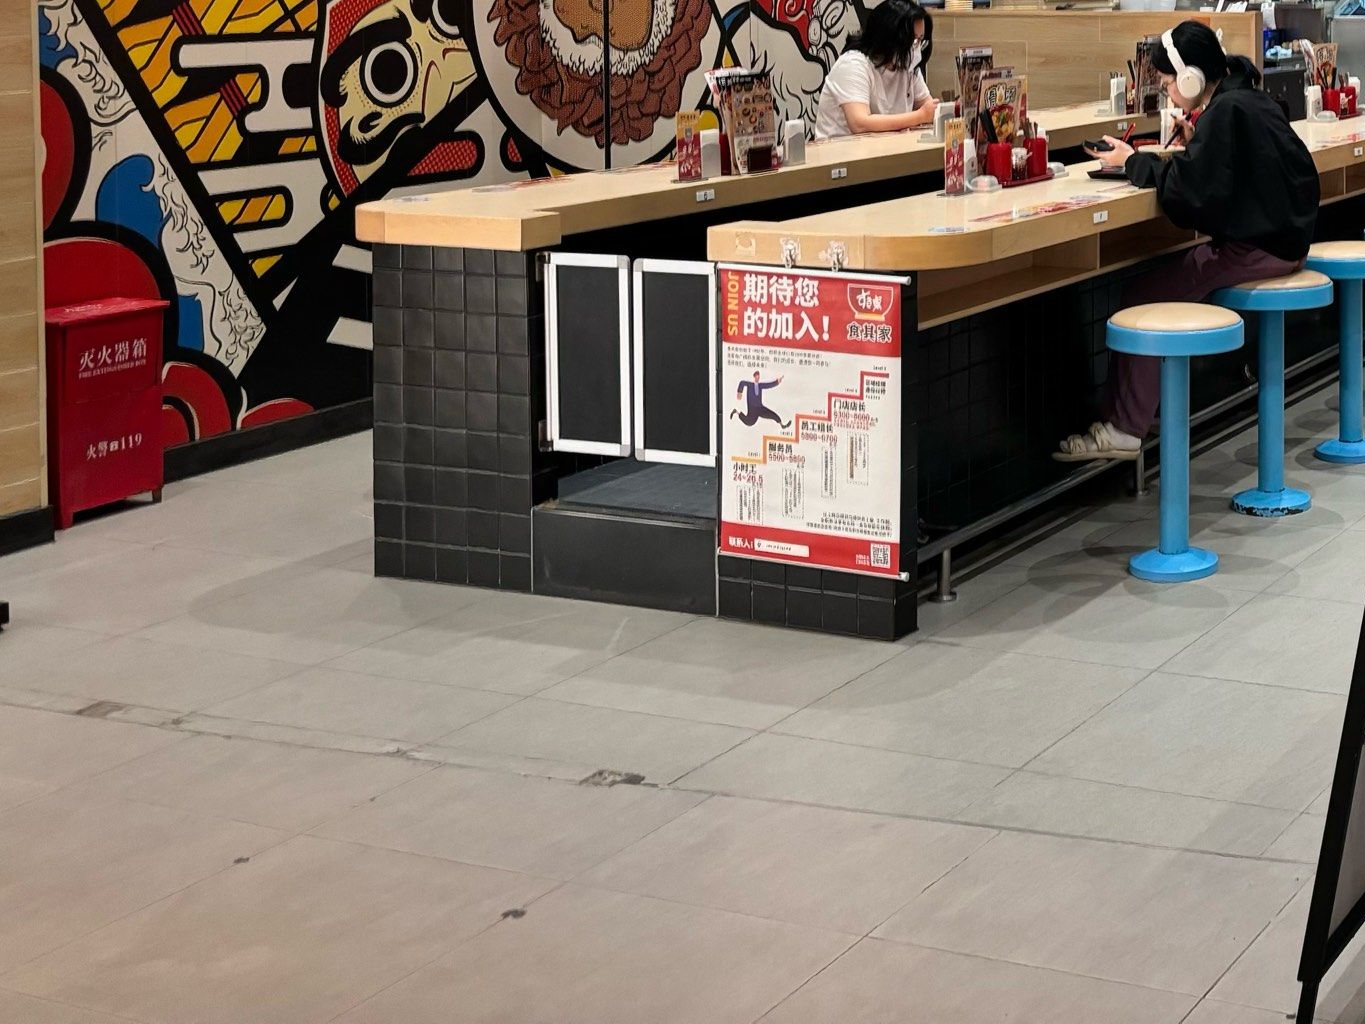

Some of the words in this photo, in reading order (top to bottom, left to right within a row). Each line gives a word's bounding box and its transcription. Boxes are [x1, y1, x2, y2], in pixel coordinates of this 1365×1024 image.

[727, 271, 740, 311] JOIN
[743, 273, 820, 308] 期待您
[727, 314, 740, 336] US
[847, 321, 893, 343] 食其家
[79, 337, 148, 371] 灭火器箱
